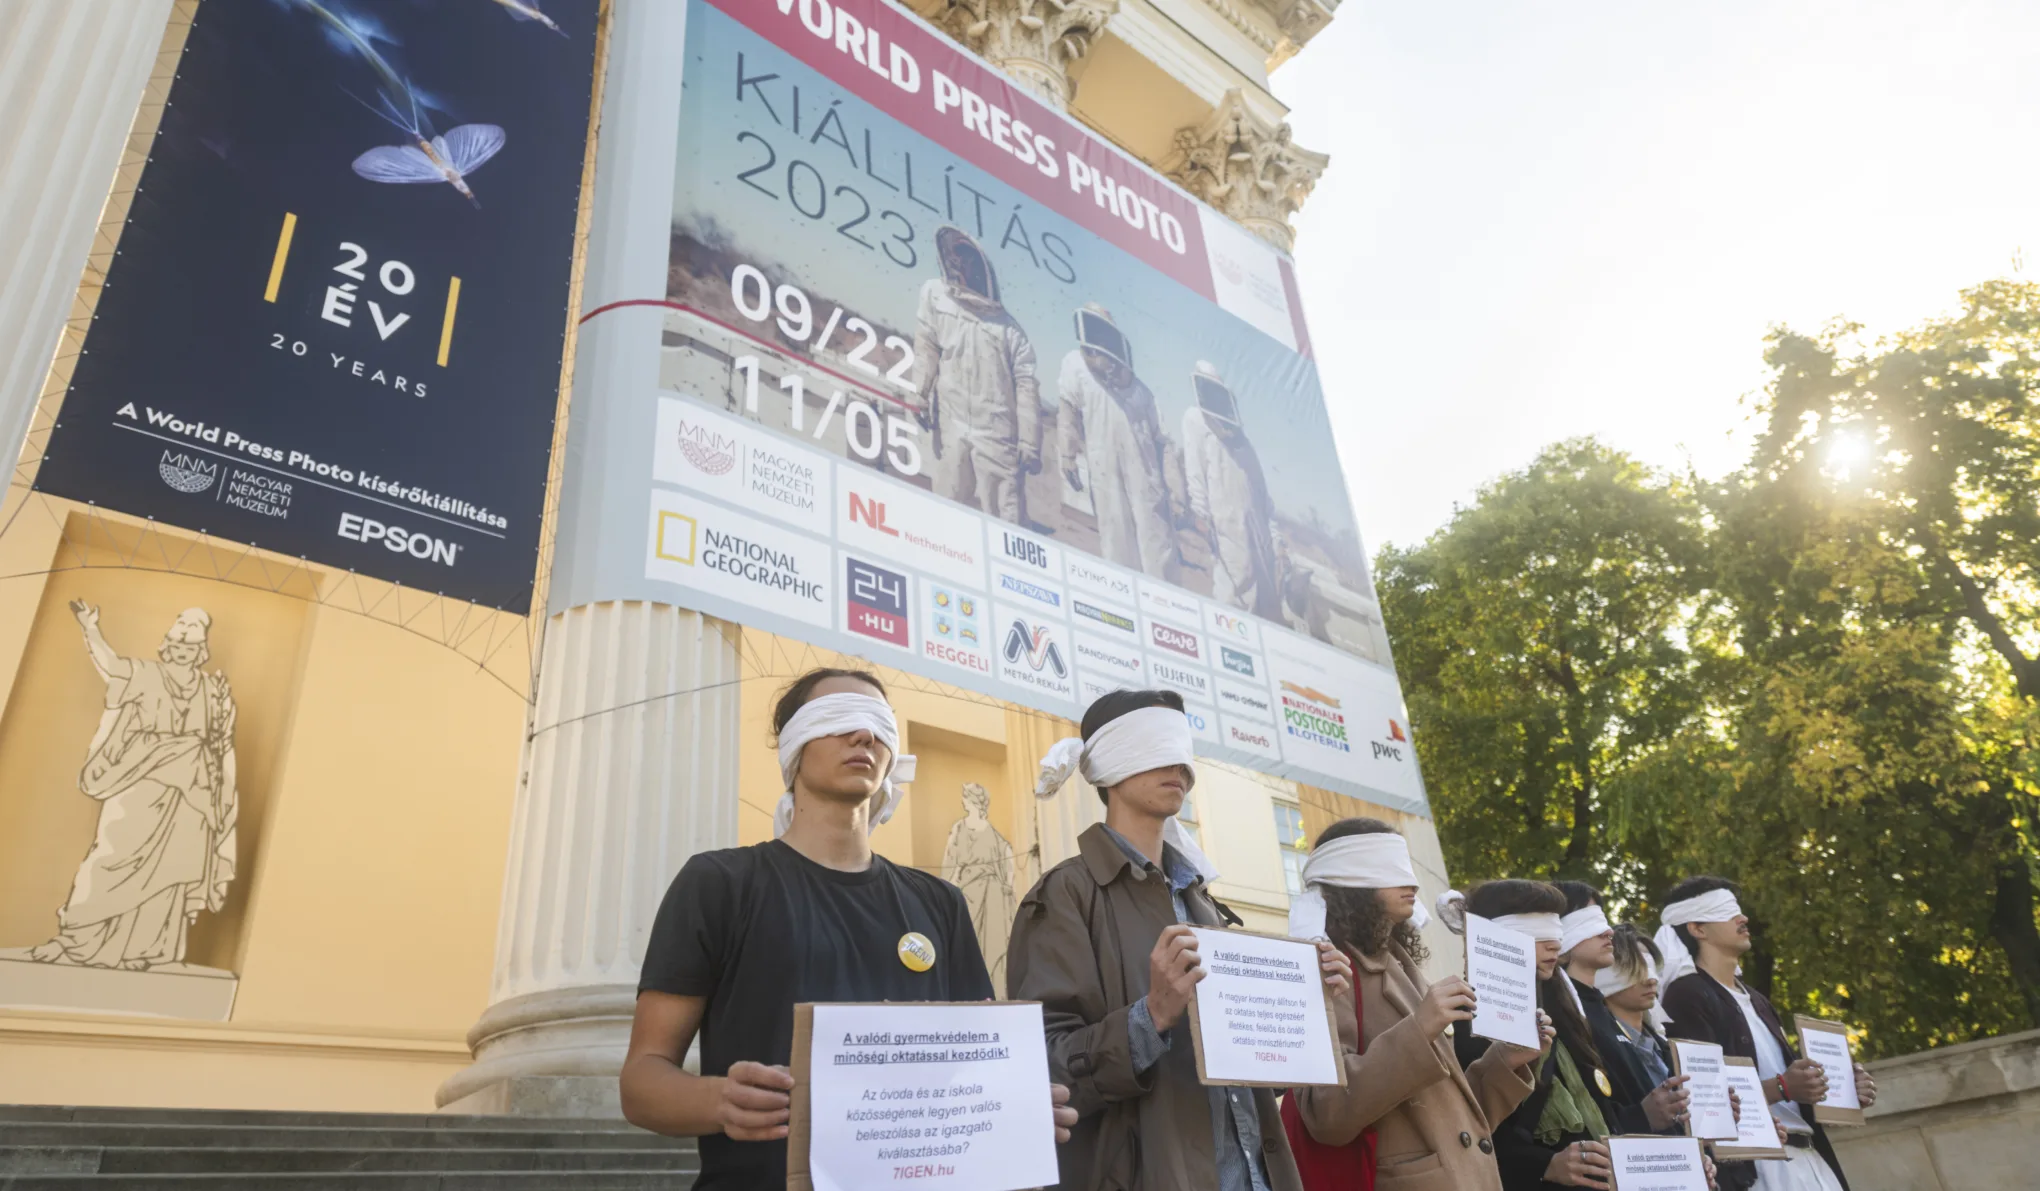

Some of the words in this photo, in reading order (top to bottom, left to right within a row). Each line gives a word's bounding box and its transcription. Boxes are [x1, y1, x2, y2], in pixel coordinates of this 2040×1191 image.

[776, 0, 921, 94] ORLD
[932, 70, 1059, 179] PRESS
[1067, 152, 1186, 255] PHOTO
[736, 51, 1077, 284] KIÁLLÍTÁS
[736, 131, 918, 269] 2023
[333, 242, 415, 295] 20
[321, 282, 411, 341] ÉV
[731, 263, 917, 393] 09/22
[270, 333, 307, 356] 20
[331, 352, 427, 398] YEARS
[734, 355, 921, 476] 11/05
[679, 420, 735, 455] MNM
[116, 402, 138, 420] A
[146, 407, 220, 443] World
[224, 431, 283, 462] Press
[288, 451, 354, 483] Photo
[358, 471, 508, 529] kísérőkiállítása
[161, 449, 217, 478] MNM
[753, 448, 813, 480] MAGYAR
[229, 481, 291, 507] NEMZETI
[233, 469, 293, 495] MAGYAR
[752, 463, 814, 497] NEMZETI
[226, 494, 288, 519] MÚZEUM
[752, 480, 814, 513] MÚZEUM
[849, 491, 899, 537] NL
[338, 512, 457, 567] EPSON
[705, 528, 799, 575] NATIONAL
[905, 532, 973, 564] Netherlands
[703, 550, 823, 602] GEOGRAPHIC
[854, 567, 900, 609] 24
[926, 641, 988, 672] REGGELI
[1036, 677, 1070, 694] REKLÁM
[1153, 663, 1205, 689] FUJIFILM
[1284, 707, 1348, 742] POSTCODE
[1287, 698, 1338, 723] NATIONALE
[1371, 740, 1402, 762] pwc
[1213, 950, 1219, 960] A
[1221, 950, 1240, 961] valódi
[1242, 955, 1295, 969] gyermekvédelem
[1242, 967, 1275, 979] oktatással
[1218, 991, 1223, 999] A
[1225, 994, 1247, 1005] magyar
[1249, 994, 1276, 1007] kormány
[1234, 1008, 1256, 1017] oktatás
[1257, 1009, 1273, 1020] teljes
[843, 1033, 852, 1044] A
[856, 1032, 890, 1043] valódi
[894, 1031, 989, 1045] gyermekvédelem
[993, 1033, 999, 1041] a
[1232, 1036, 1256, 1045] oktatási
[1278, 1025, 1285, 1033] és
[834, 1050, 888, 1065] minőségi
[892, 1049, 949, 1062] oktatással
[951, 1047, 1009, 1060] kezdődik!
[1255, 1052, 1287, 1062] 7IGEN.hu
[862, 1089, 876, 1101] Az
[880, 1087, 913, 1100] óvoda
[916, 1087, 929, 1099] és
[932, 1089, 946, 1098] az
[949, 1084, 983, 1097] iskola
[846, 1106, 925, 1123] közösségének
[928, 1104, 966, 1119] legyen
[970, 1101, 1001, 1114] valós
[856, 1127, 921, 1142] beleszólása
[924, 1128, 938, 1136] az
[941, 1121, 992, 1137] igazgató
[878, 1142, 969, 1160] kiválasztásába?
[893, 1164, 954, 1180] 7IGEN.hu
